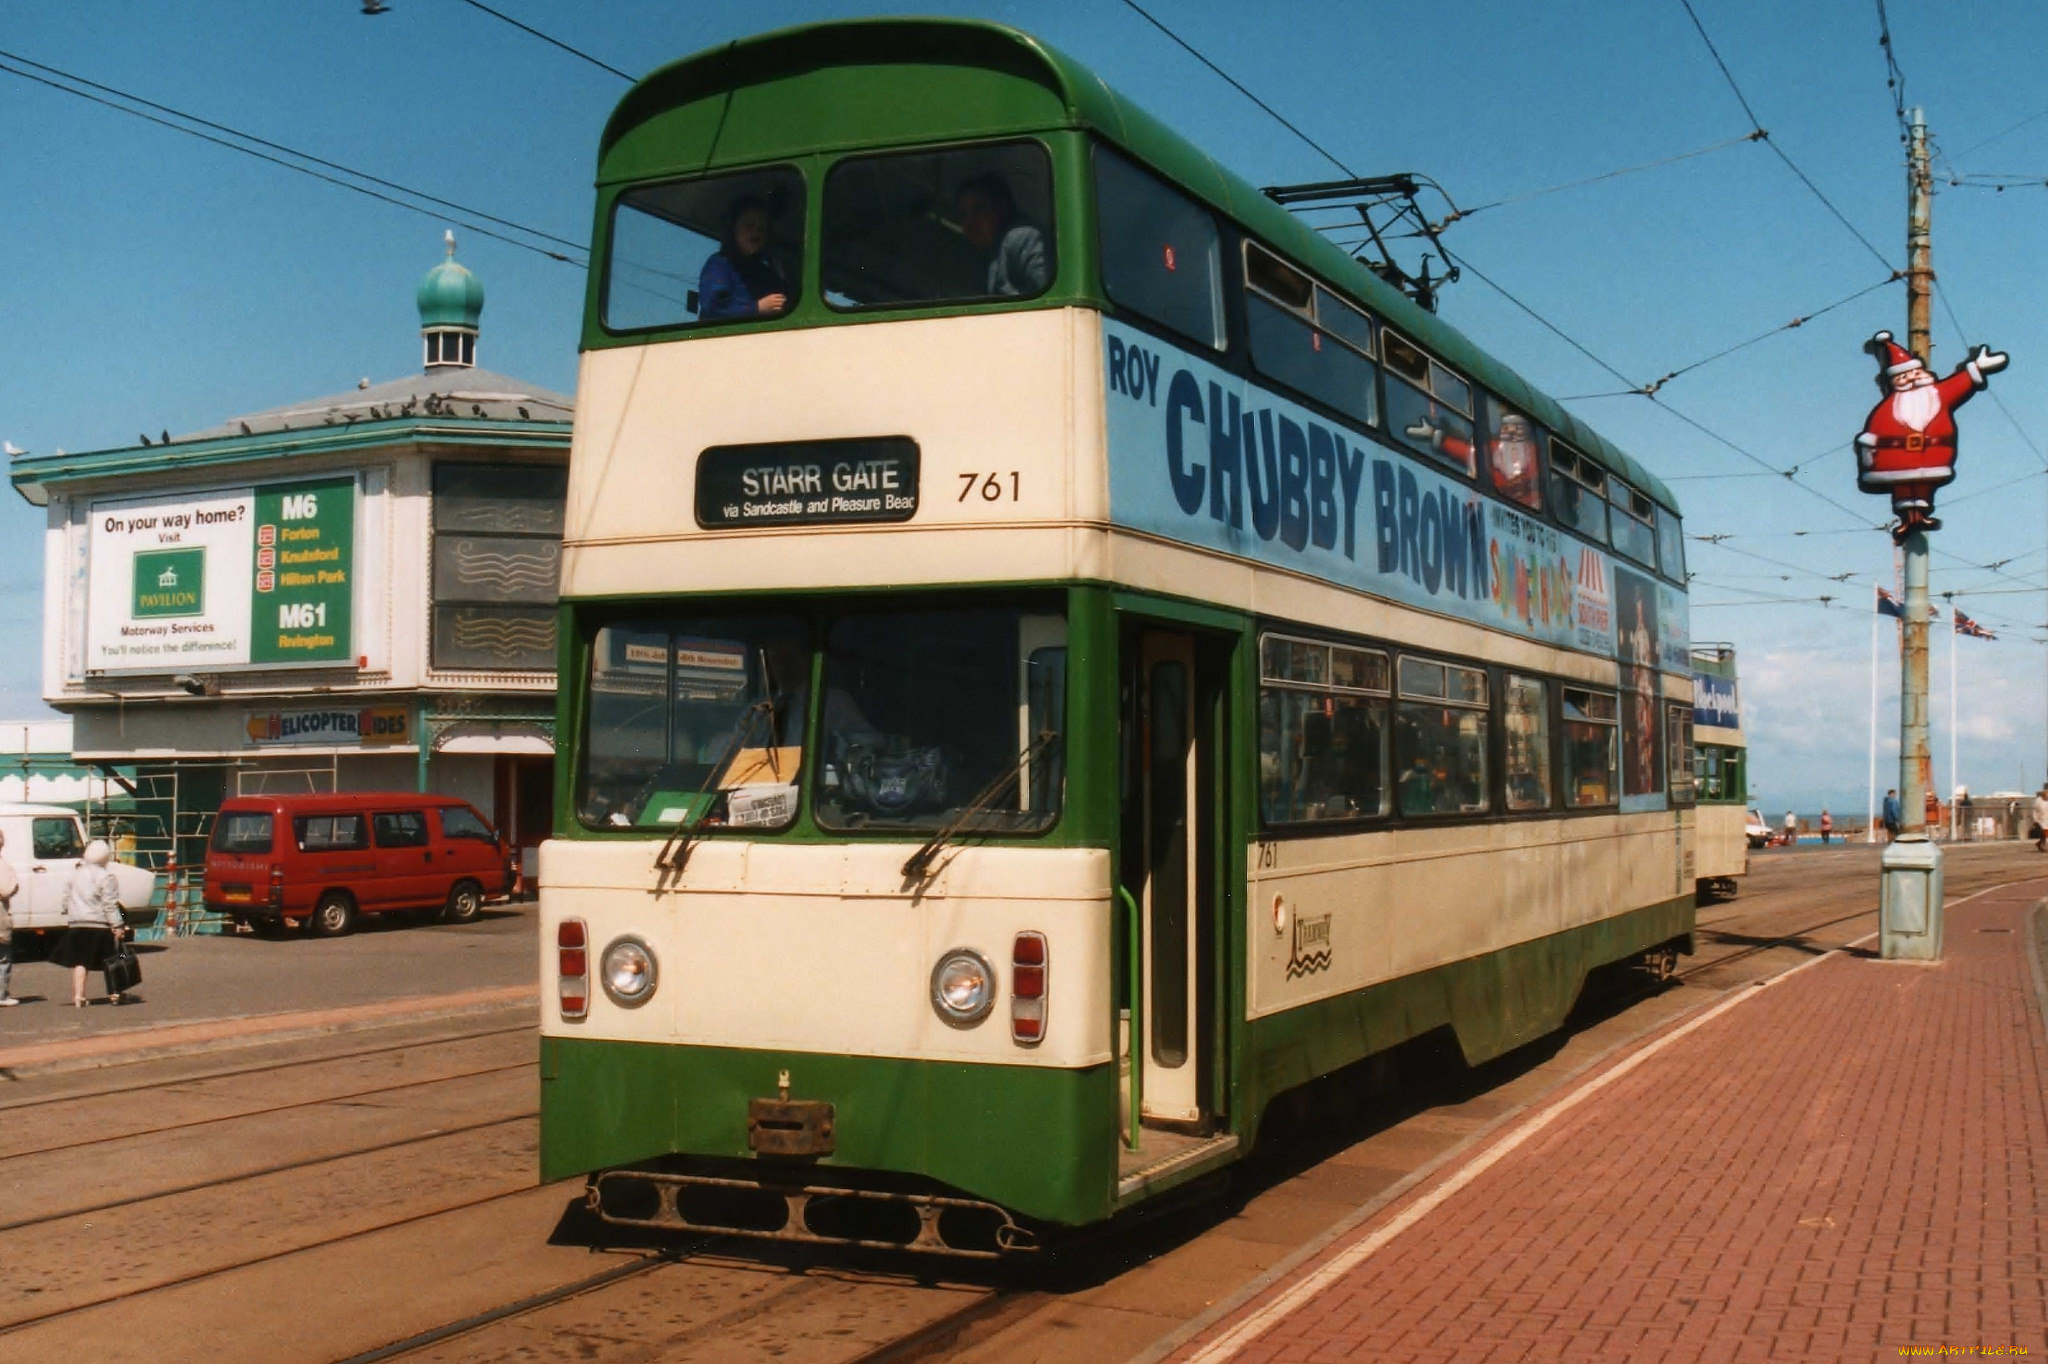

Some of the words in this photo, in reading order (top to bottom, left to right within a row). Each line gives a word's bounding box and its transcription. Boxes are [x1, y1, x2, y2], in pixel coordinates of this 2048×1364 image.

[1108, 333, 1160, 407] ROY
[742, 465, 822, 497] STARR
[832, 460, 900, 491] GATE
[957, 471, 1020, 503] 761
[1165, 368, 1365, 562] CHUBBY
[1372, 459, 1489, 601] BROWN
[105, 517, 124, 532] On
[128, 516, 158, 533] your
[162, 514, 191, 529] way
[196, 505, 246, 525] home?
[281, 494, 318, 520] M6
[723, 503, 739, 518] via
[743, 499, 803, 517] Sandcastle
[807, 498, 828, 513] and
[831, 495, 880, 513] Pleasure
[158, 533, 181, 543] Visit
[281, 528, 320, 541] Forton
[317, 570, 346, 583] Park
[139, 592, 196, 608] PAVILION
[279, 602, 327, 629] M61
[121, 625, 168, 637] Motorway
[171, 622, 215, 634] Services
[163, 642, 179, 653] the
[269, 713, 357, 740] HELICOPTER
[1258, 842, 1277, 869] 761
